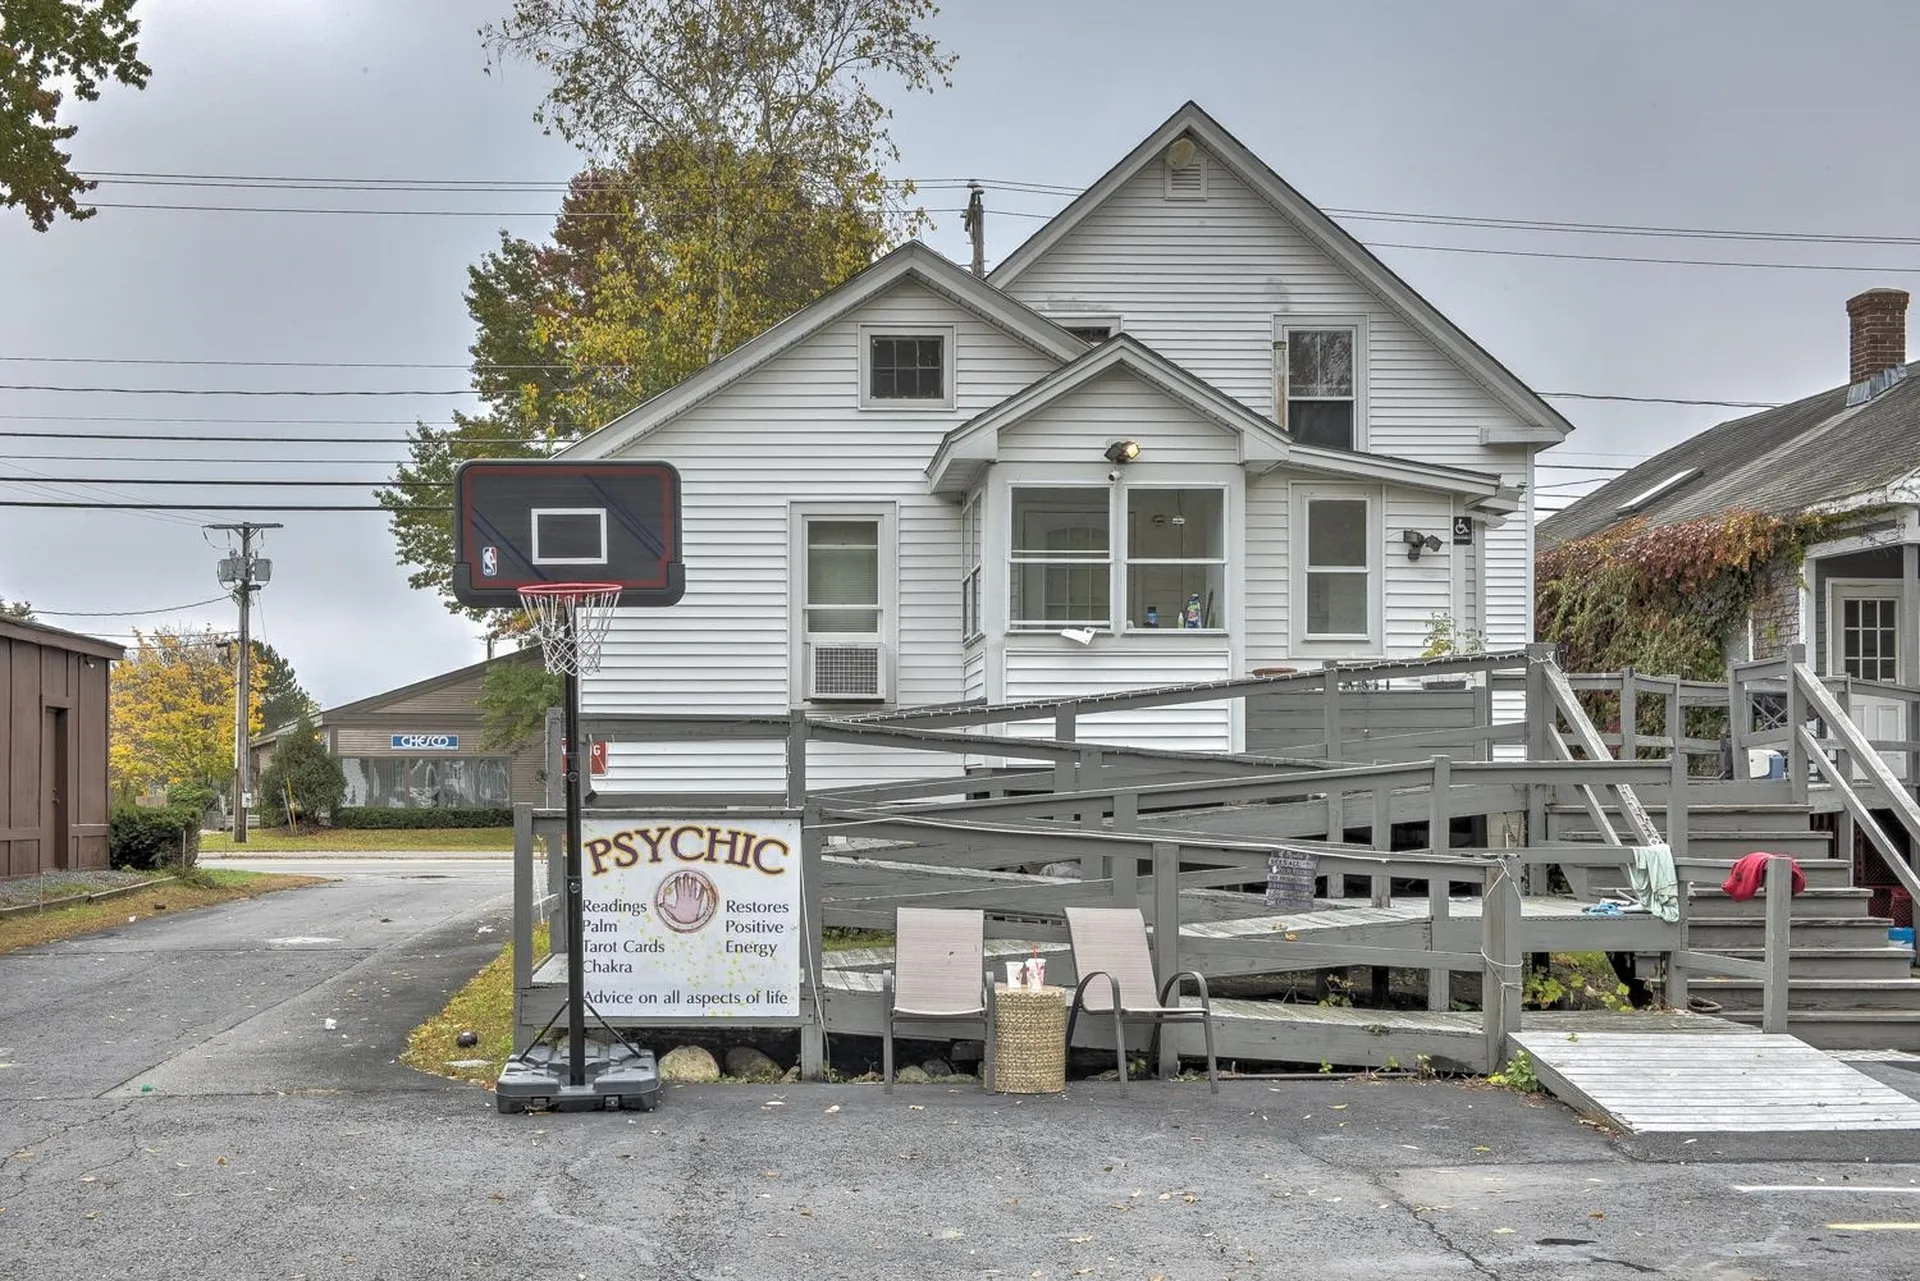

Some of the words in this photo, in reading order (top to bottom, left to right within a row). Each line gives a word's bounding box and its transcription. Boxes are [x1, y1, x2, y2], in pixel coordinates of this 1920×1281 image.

[401, 735, 449, 747] CHESCO
[583, 825, 791, 877] PSYCHIC
[582, 899, 648, 917] Readings
[726, 900, 790, 914] Restores
[582, 919, 618, 933] Palm
[725, 919, 784, 934] Positive
[583, 940, 617, 953] Tarot
[623, 939, 666, 953] Cards
[725, 940, 778, 958] Energy
[582, 959, 633, 974] Chakra
[583, 990, 634, 1004] Advice
[638, 994, 658, 1004] on
[663, 989, 681, 1004] all
[686, 993, 741, 1008] aspects
[745, 990, 761, 1004] of
[766, 990, 789, 1004] life
